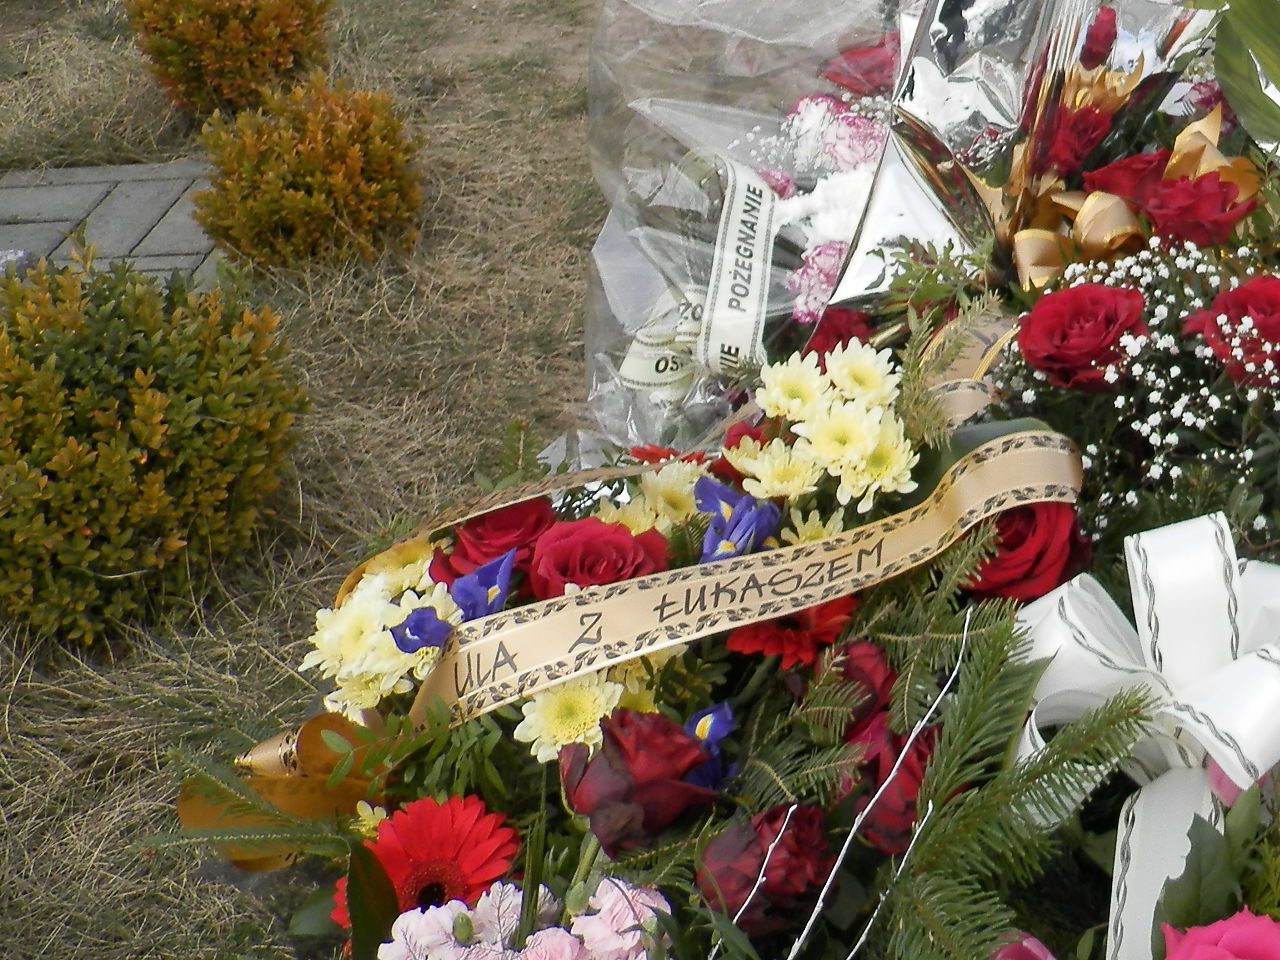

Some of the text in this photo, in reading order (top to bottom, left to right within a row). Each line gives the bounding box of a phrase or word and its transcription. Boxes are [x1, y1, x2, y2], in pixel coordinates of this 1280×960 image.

[728, 183, 764, 313] POŻEGNANIE
[568, 612, 603, 654] Z
[652, 537, 885, 623] ŁUKASZEM
